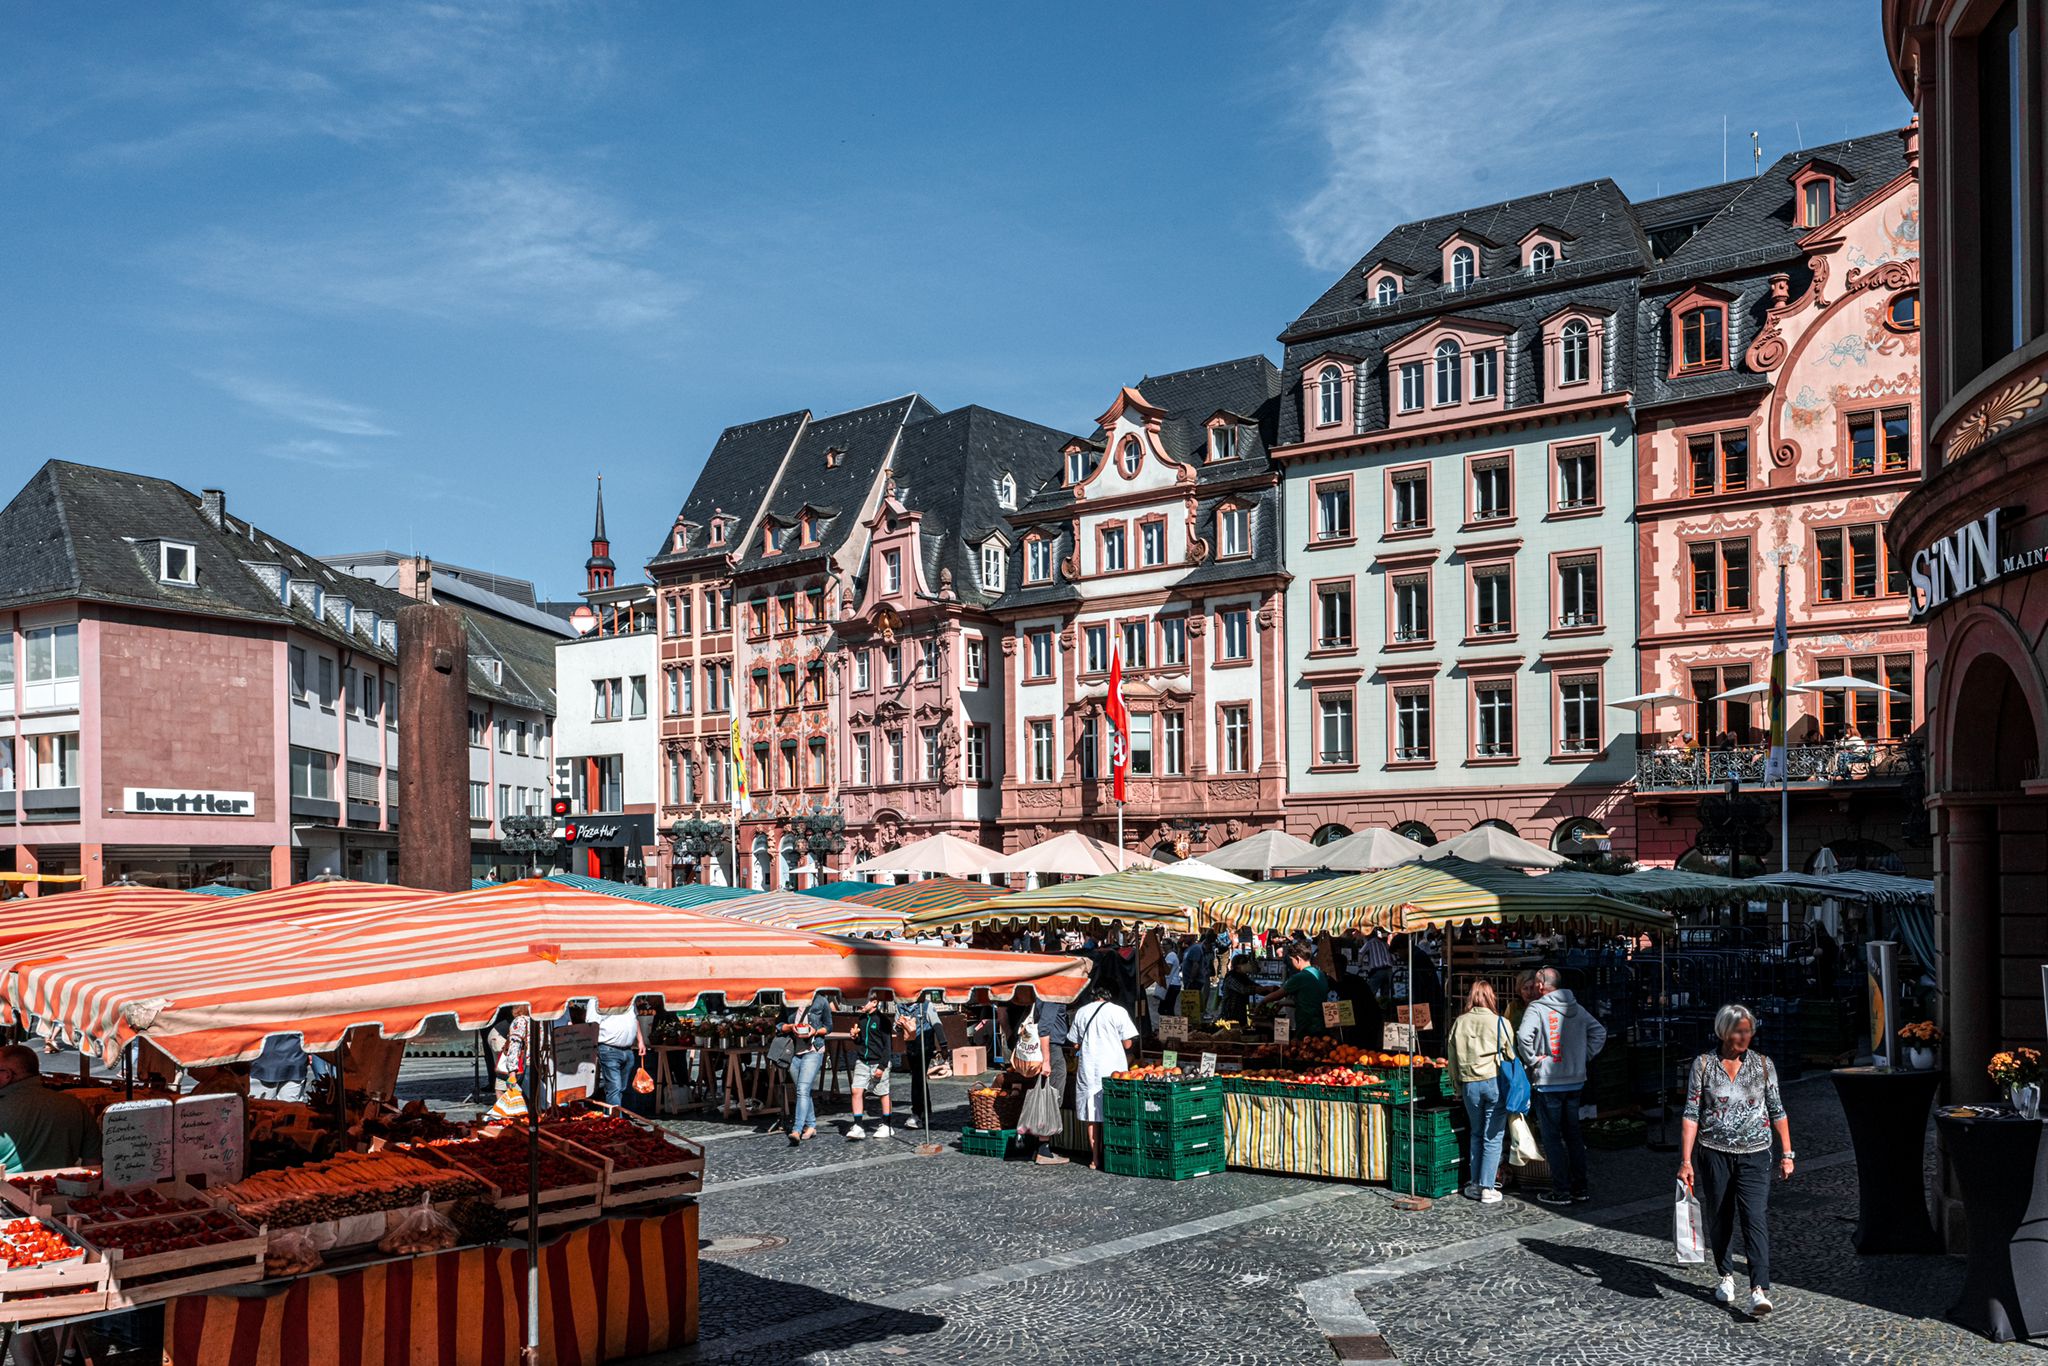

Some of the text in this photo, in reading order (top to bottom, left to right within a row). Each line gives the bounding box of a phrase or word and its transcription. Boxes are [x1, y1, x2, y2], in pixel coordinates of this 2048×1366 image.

[1879, 633, 1904, 645] ZUM
[136, 791, 249, 813] buttler
[576, 824, 621, 839] Pizza Hut
